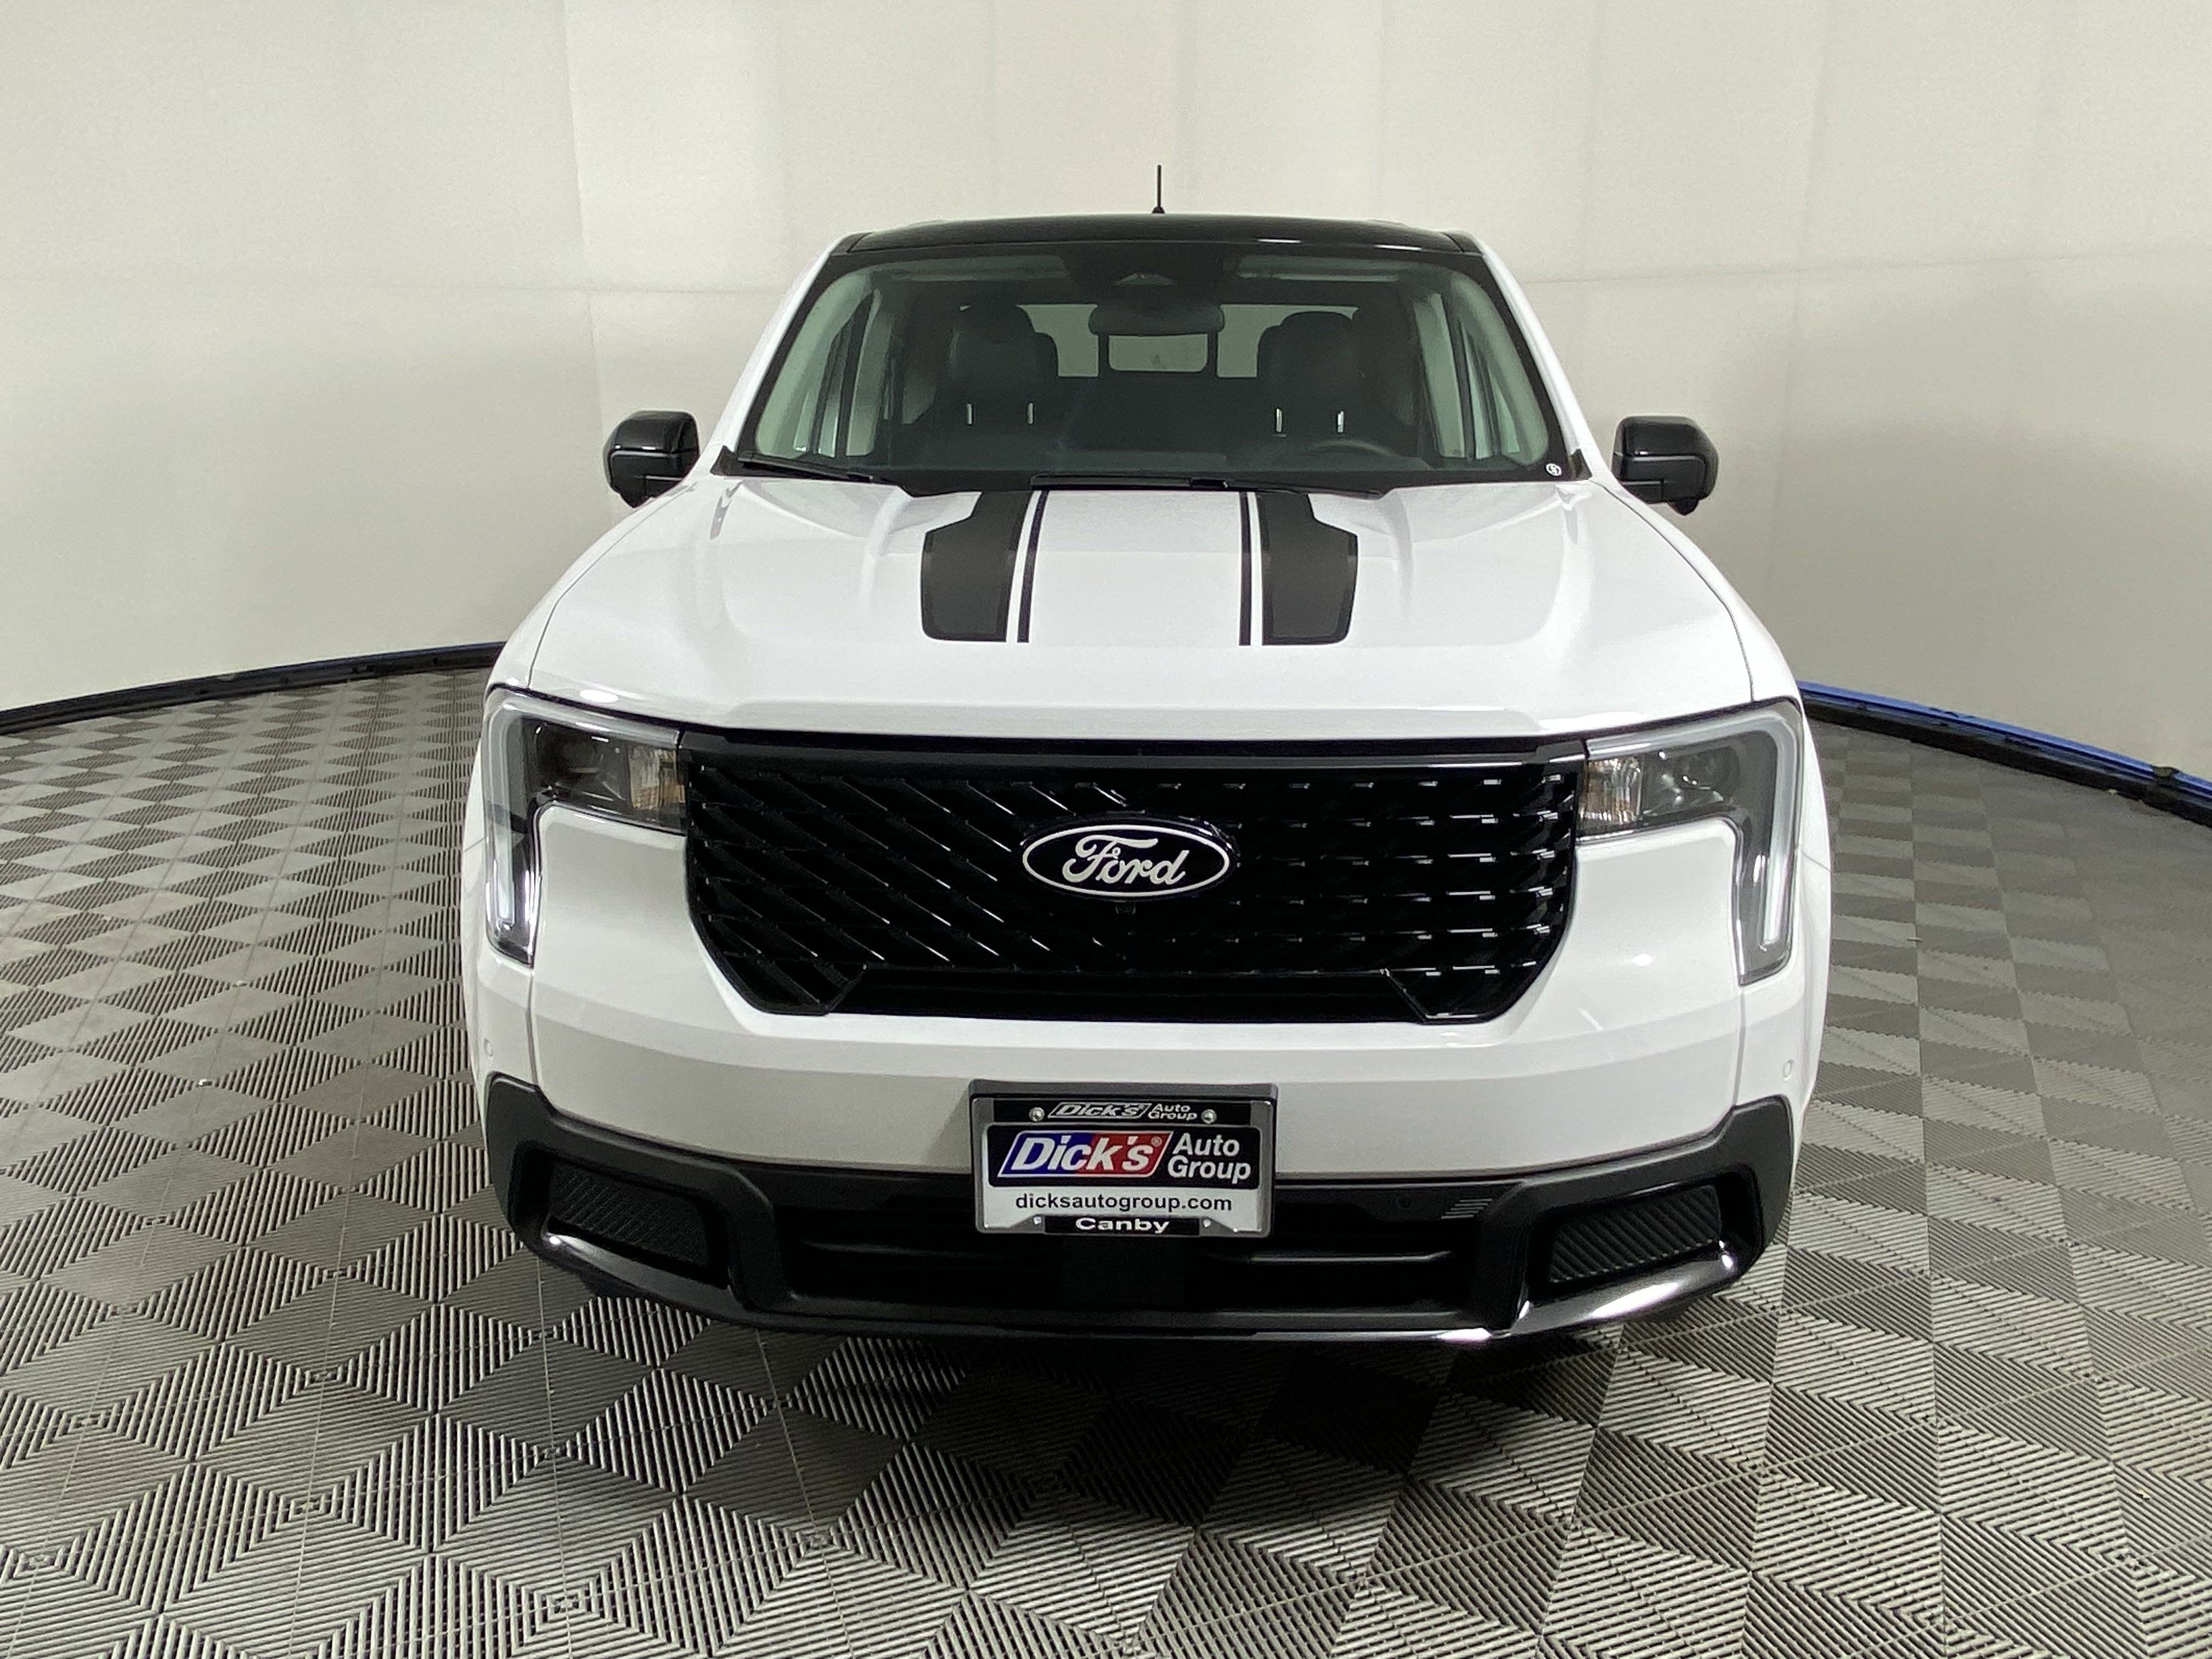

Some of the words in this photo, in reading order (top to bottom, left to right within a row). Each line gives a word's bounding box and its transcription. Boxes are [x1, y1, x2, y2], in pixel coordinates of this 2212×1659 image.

[1062, 834, 1189, 885] Ford
[1148, 1111, 1197, 1121] Group
[1152, 1103, 1190, 1113] Auto
[1172, 1132, 1240, 1157] Auto
[1167, 1155, 1251, 1184] Group
[1015, 1193, 1232, 1211] dicksautogroup.com
[1075, 1217, 1170, 1234] Canby
